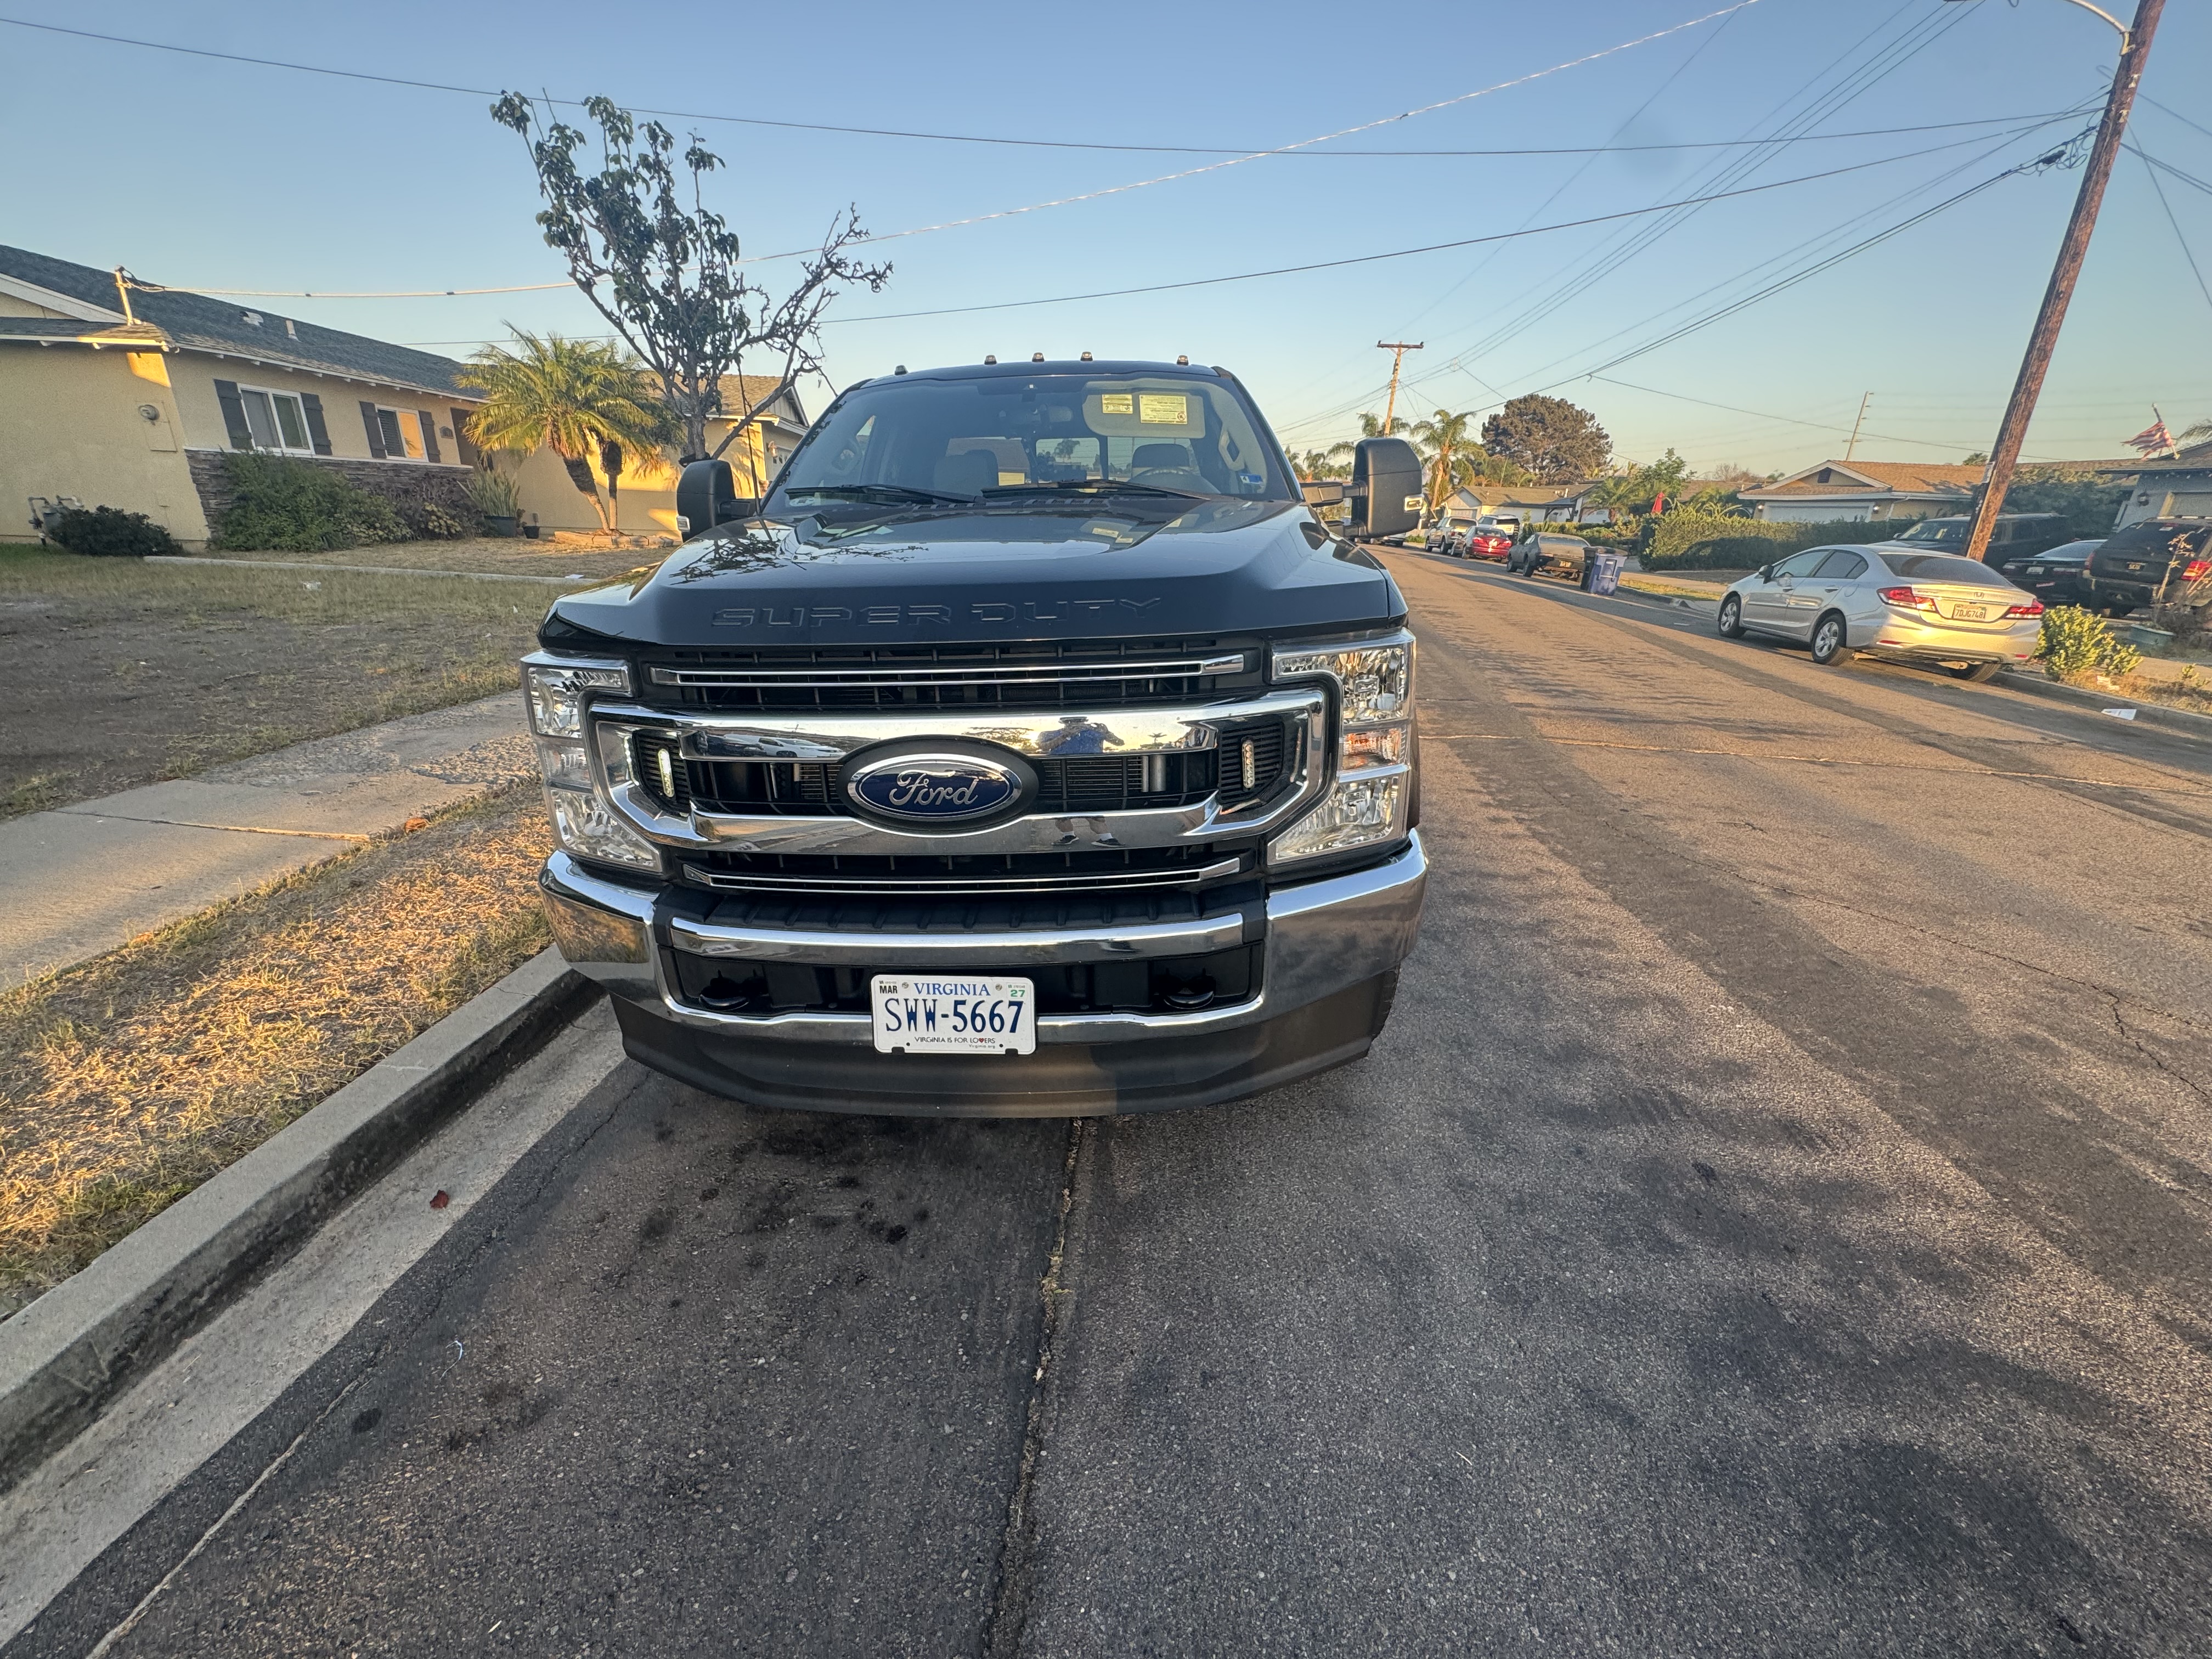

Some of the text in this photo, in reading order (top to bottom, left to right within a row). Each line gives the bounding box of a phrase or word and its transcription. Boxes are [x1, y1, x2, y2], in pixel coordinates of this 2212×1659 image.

[712, 597, 1161, 628] SUPER DUTY
[889, 769, 979, 806] Ford
[879, 985, 898, 994] MAR
[913, 983, 991, 996] VIRGINIA
[1010, 989, 1025, 997] 27
[884, 998, 1024, 1033] SWW-5667
